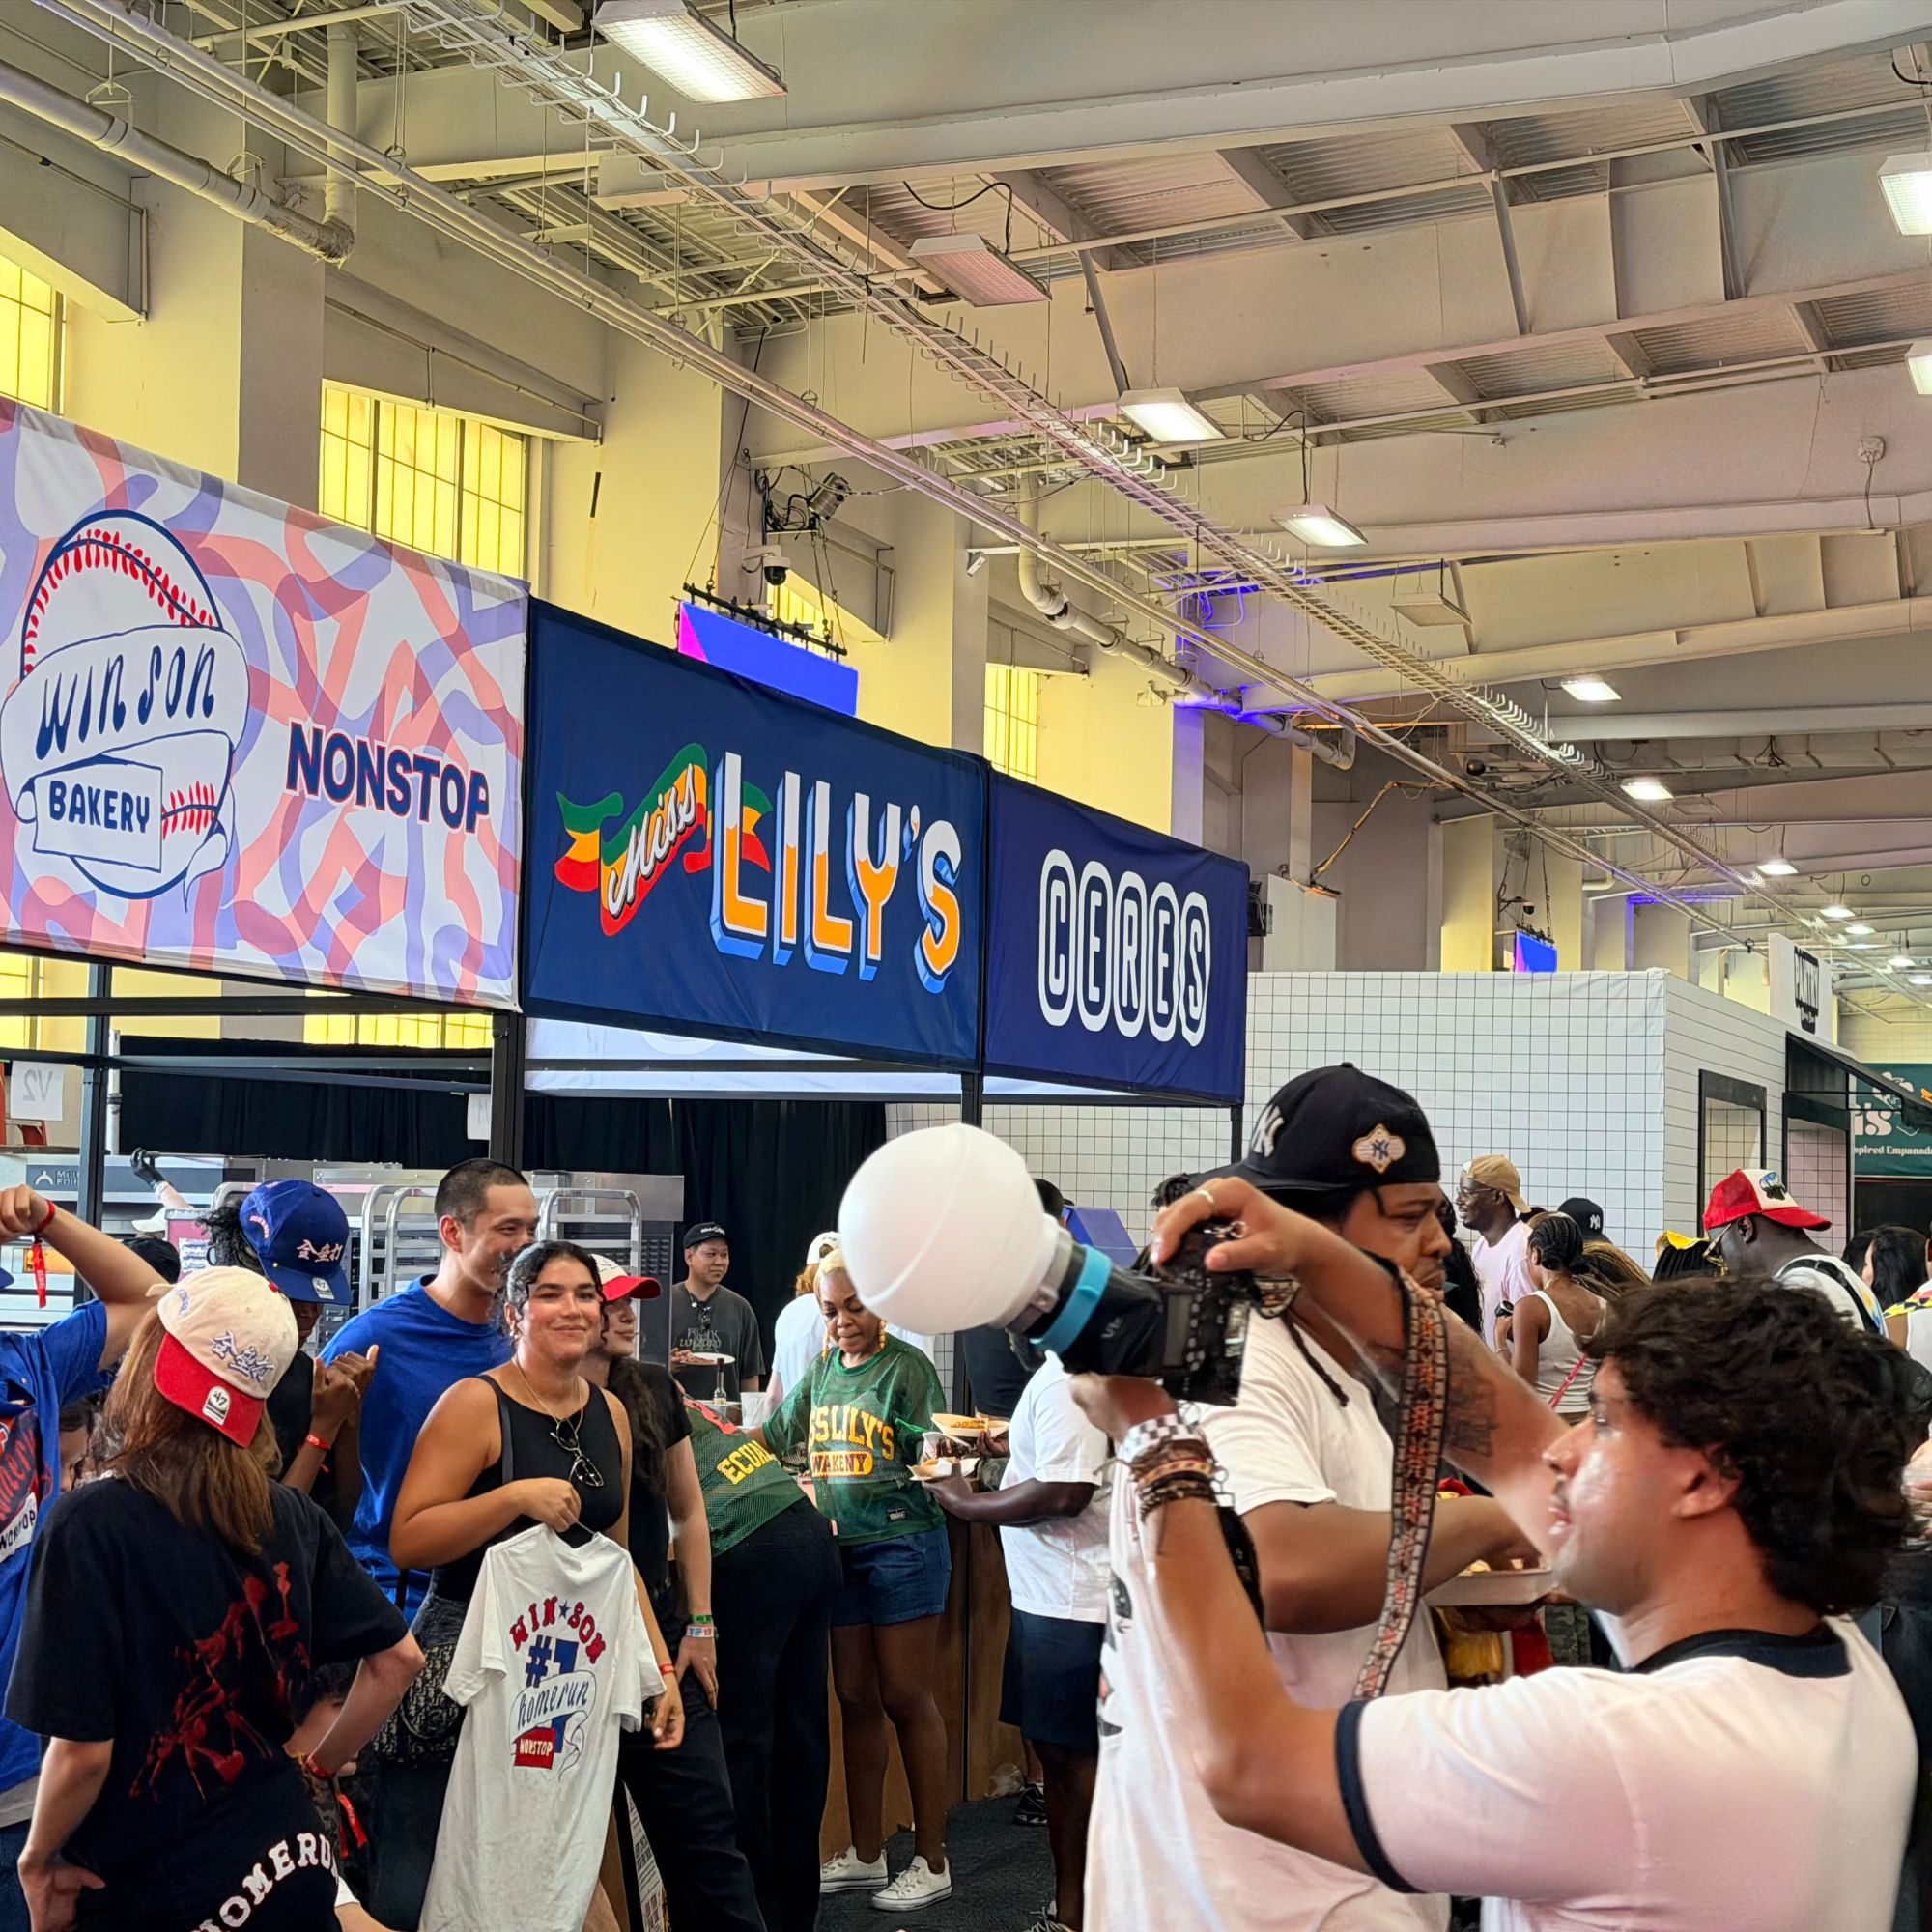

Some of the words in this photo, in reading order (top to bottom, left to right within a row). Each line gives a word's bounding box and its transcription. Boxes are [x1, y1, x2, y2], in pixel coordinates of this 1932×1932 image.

[49, 781, 151, 834] BAKERY
[286, 721, 490, 834] NONSTOP
[608, 762, 696, 919] Miss
[710, 752, 962, 994] LILY'S
[1038, 849, 1210, 1047] CERES
[1886, 1145, 1932, 1157] Empanad
[509, 1596, 558, 1651] WIN
[567, 1601, 606, 1664] SON
[519, 1739, 554, 1757] NONSTOP
[191, 1832, 339, 1932] OMERU
